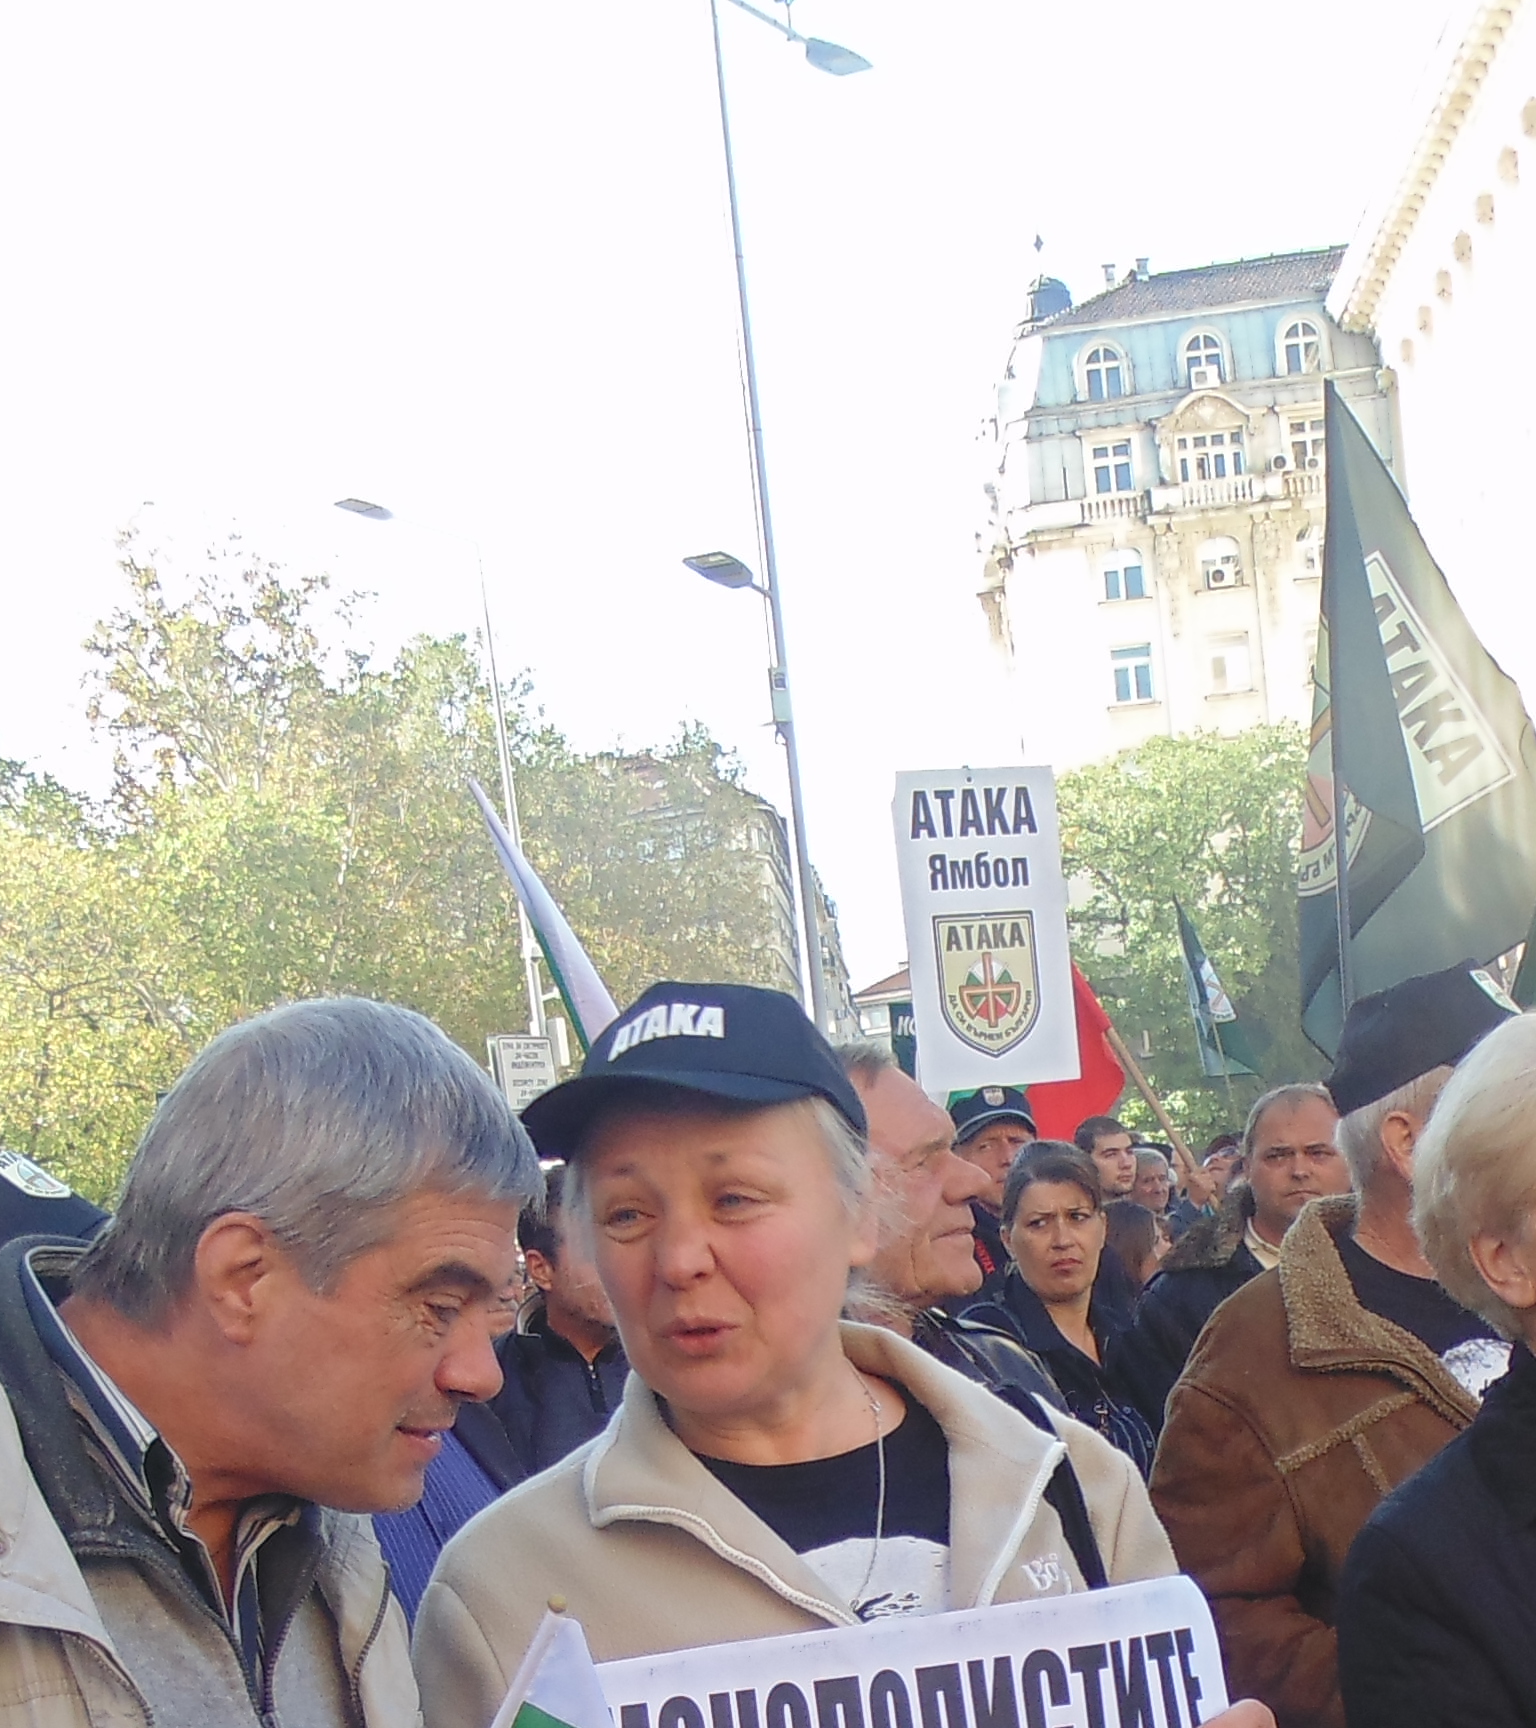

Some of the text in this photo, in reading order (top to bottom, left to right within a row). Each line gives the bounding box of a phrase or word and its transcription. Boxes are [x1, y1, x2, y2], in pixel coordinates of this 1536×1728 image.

[910, 786, 1039, 840] АТАКА
[928, 852, 1031, 891] Ямбол
[945, 922, 1026, 952] АТАКА
